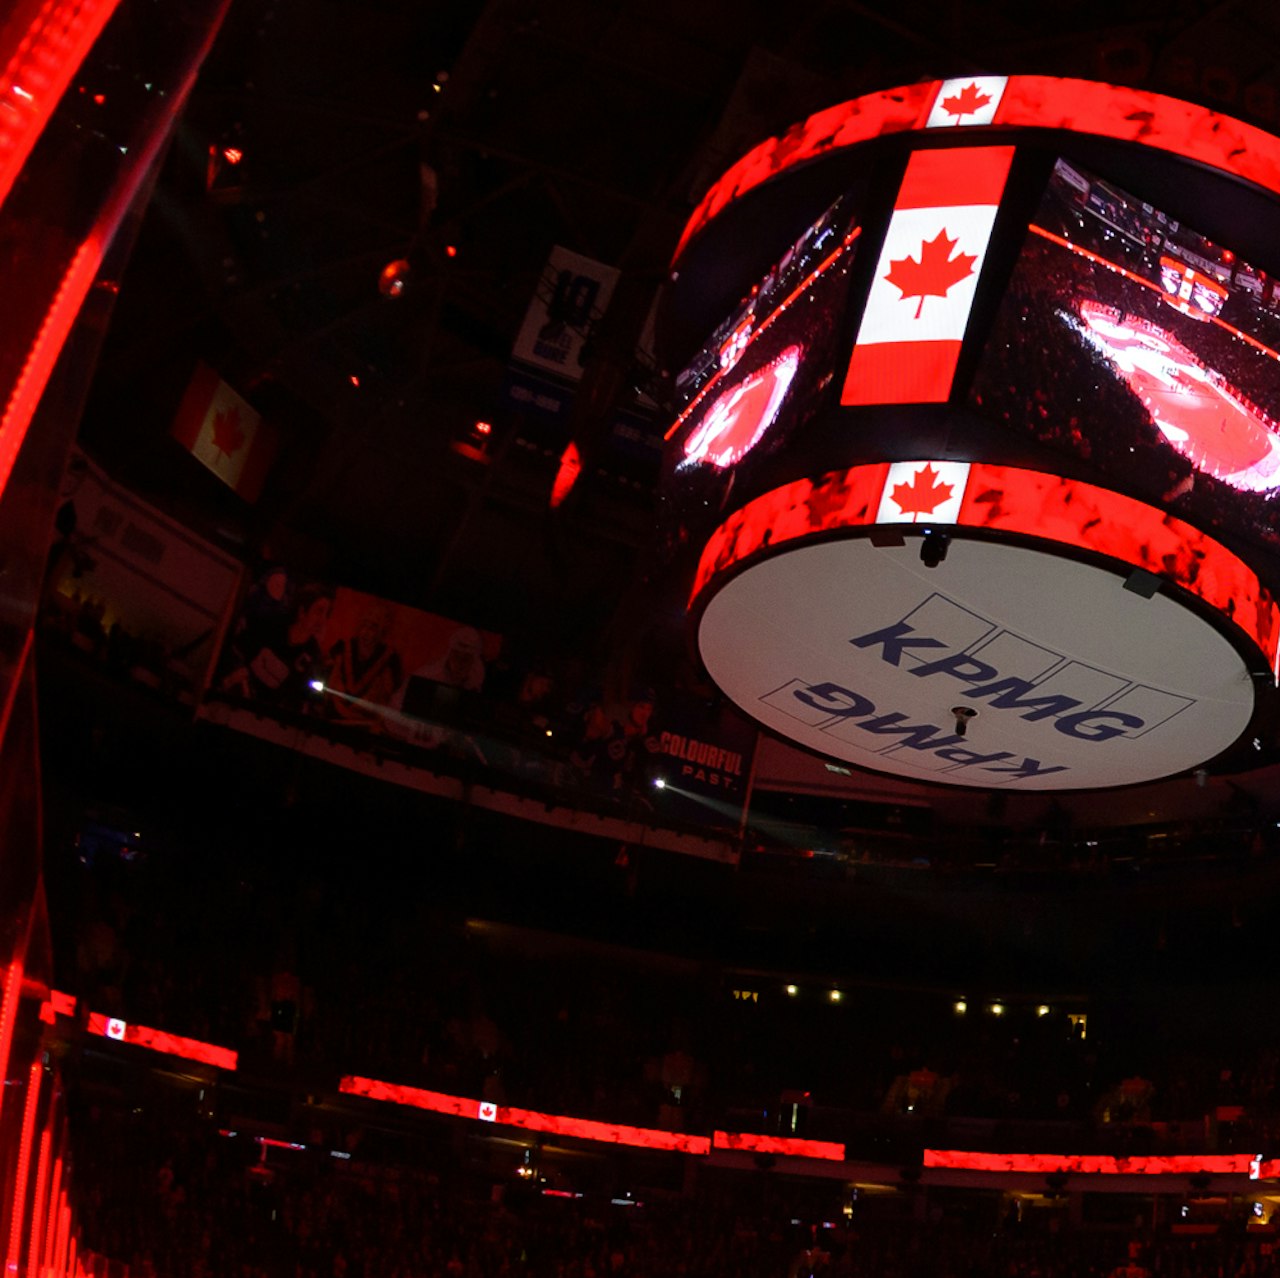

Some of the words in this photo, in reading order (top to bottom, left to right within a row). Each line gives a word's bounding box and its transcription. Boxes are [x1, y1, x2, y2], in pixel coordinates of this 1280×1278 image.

[849, 620, 1145, 742] KPMG
[660, 731, 742, 777] COLOURFUL
[793, 682, 1071, 778] KPMG
[681, 764, 739, 793] PAST.
